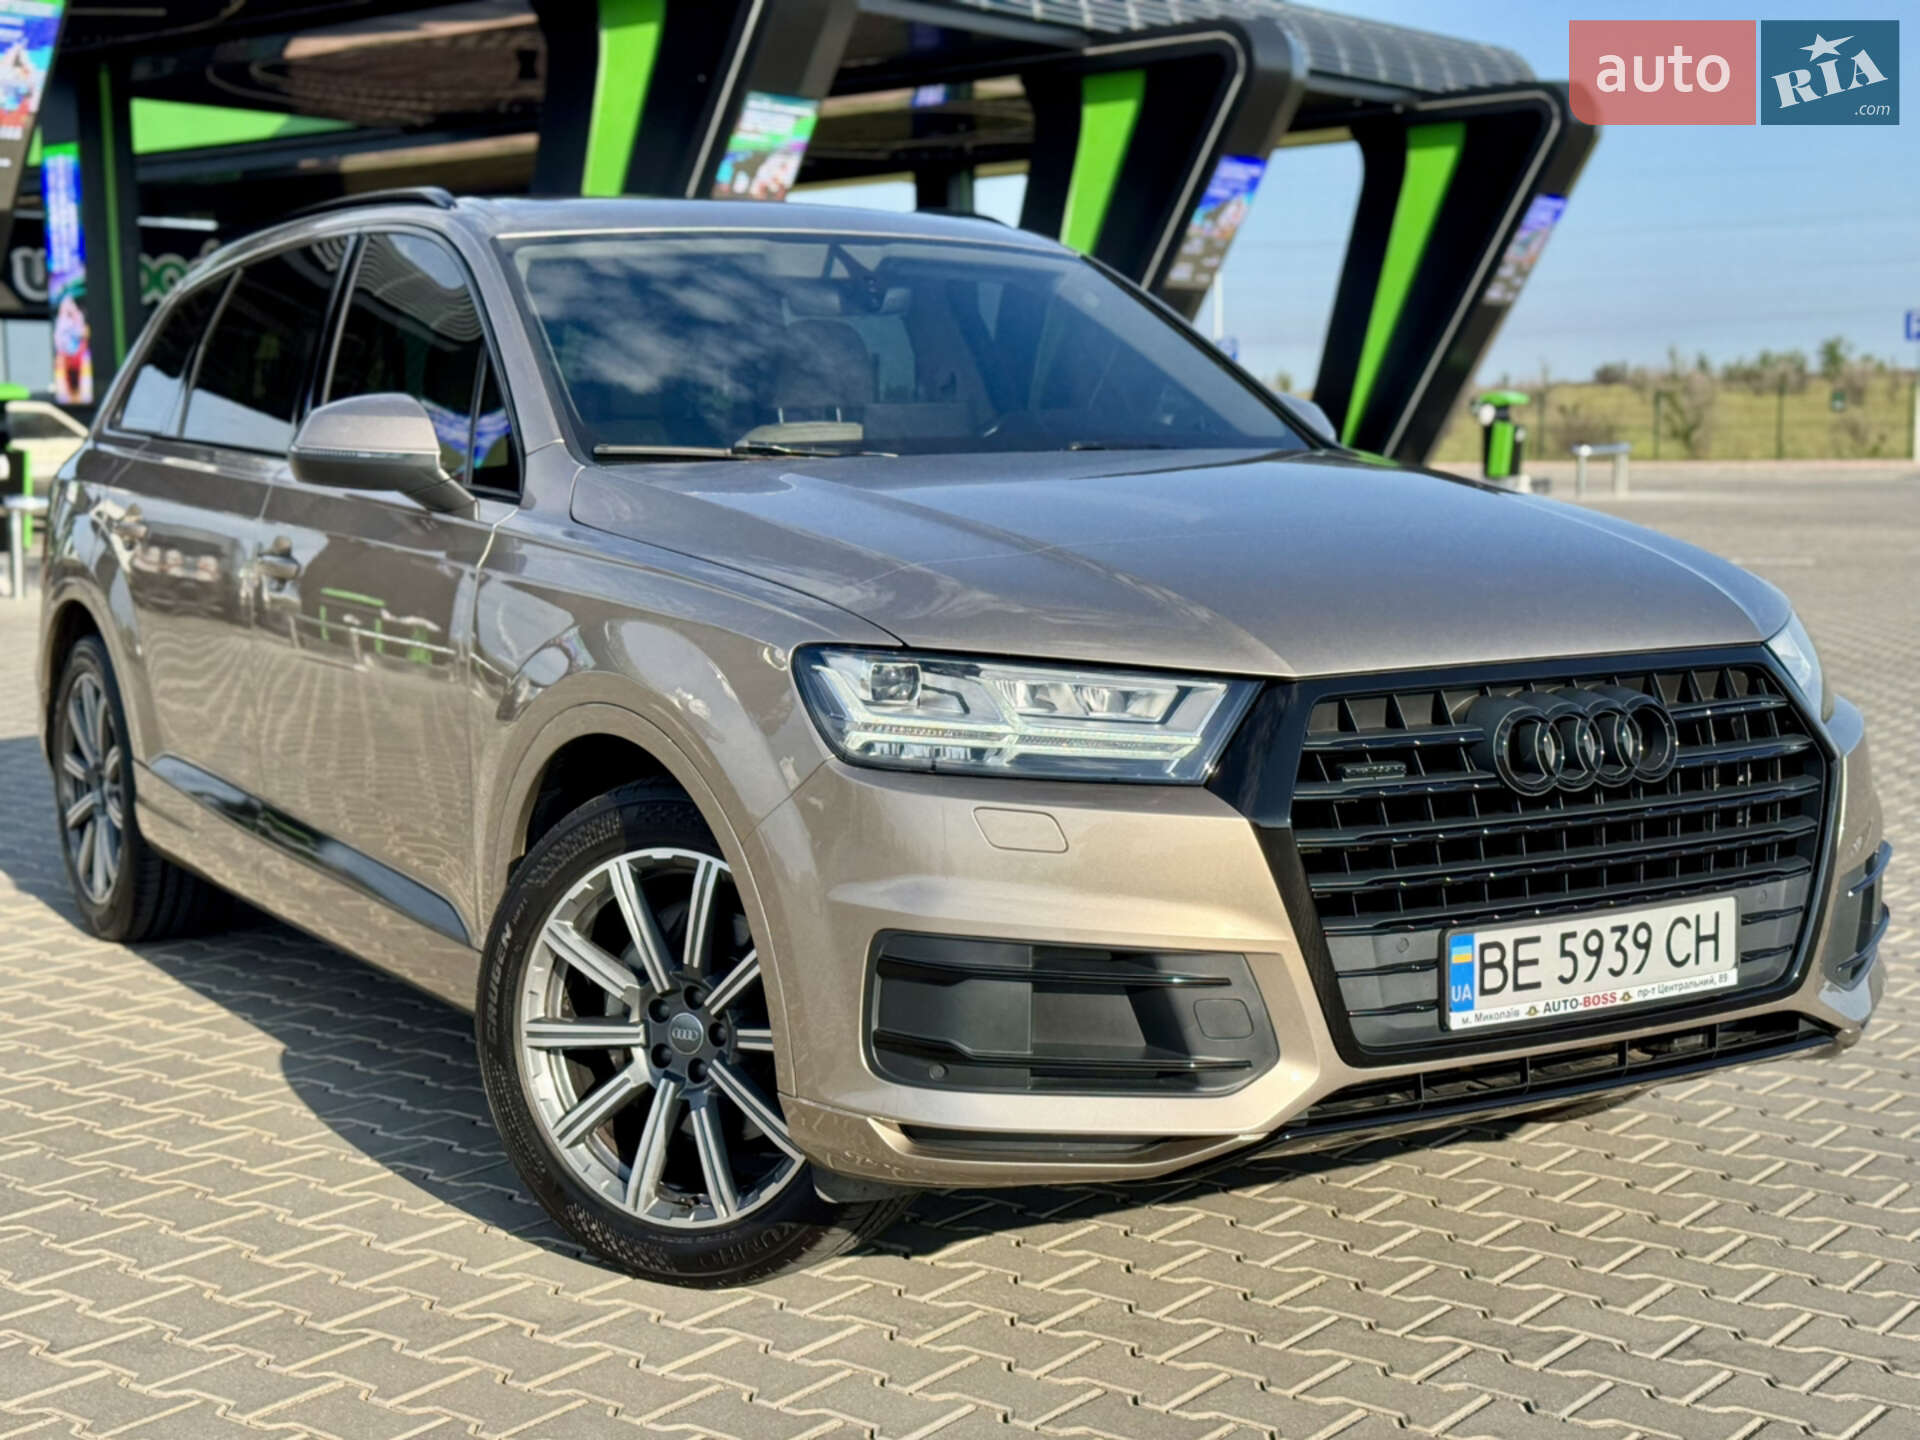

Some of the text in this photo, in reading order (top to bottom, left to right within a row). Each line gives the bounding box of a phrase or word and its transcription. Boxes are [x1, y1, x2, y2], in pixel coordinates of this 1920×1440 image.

[1478, 911, 1721, 997] BE 5939 CH
[1451, 984, 1473, 1003] UA
[1543, 992, 1617, 1014] AUTO-BOSS
